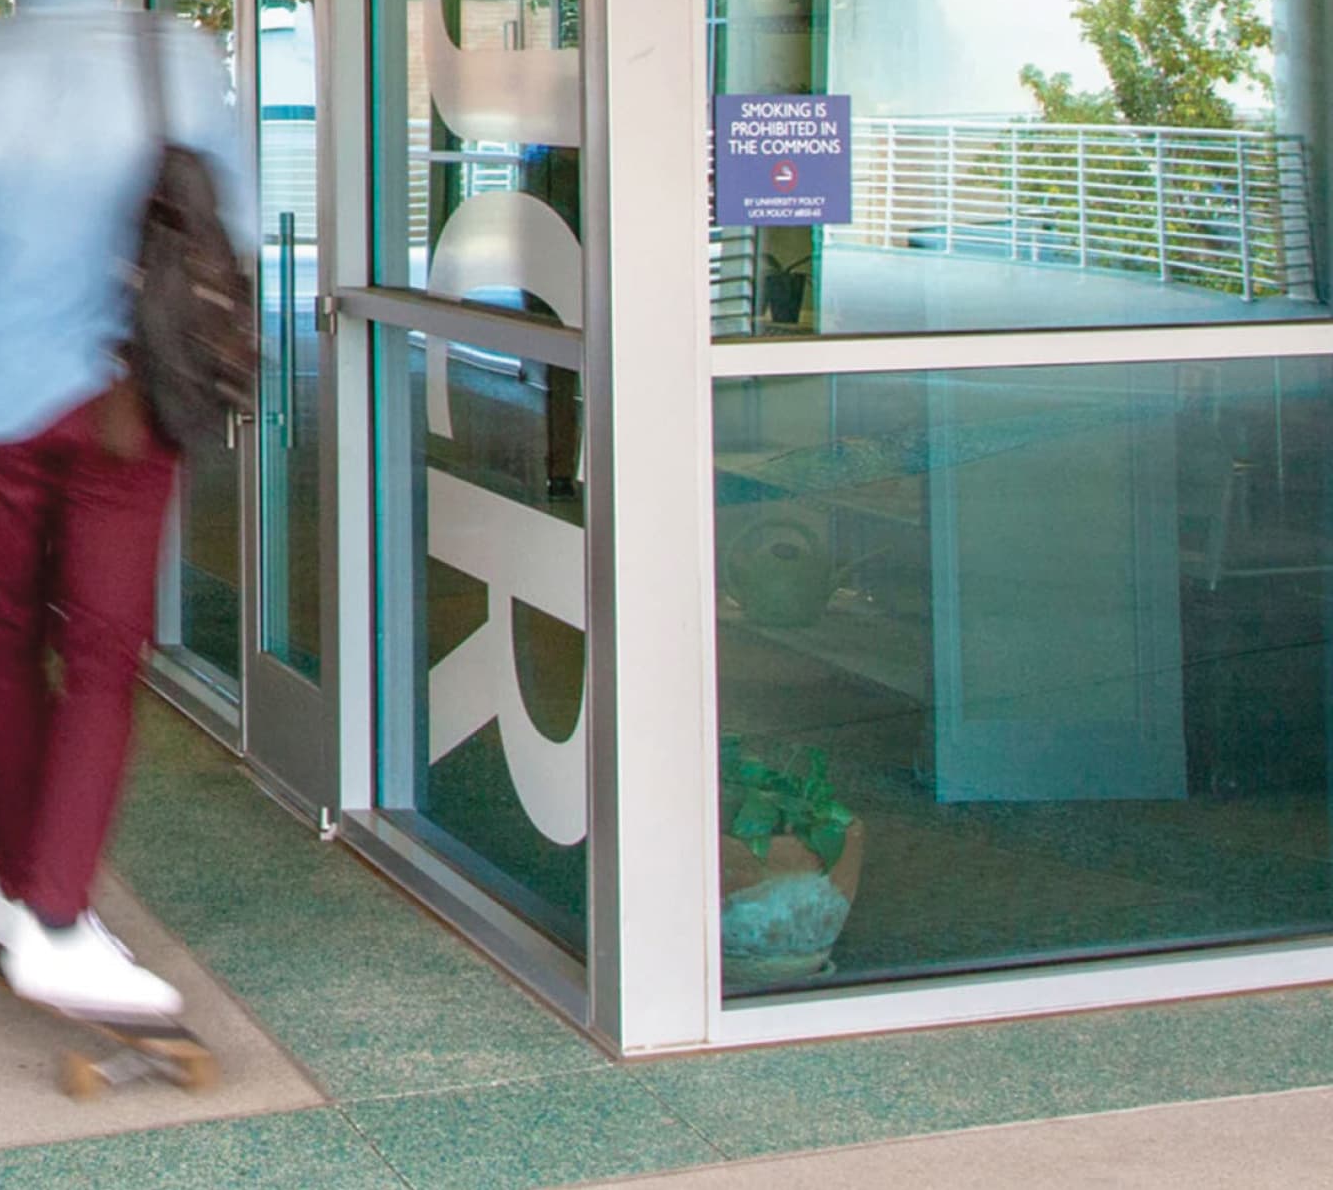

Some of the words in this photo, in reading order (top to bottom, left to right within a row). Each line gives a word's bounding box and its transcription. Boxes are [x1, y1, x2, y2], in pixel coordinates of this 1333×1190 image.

[741, 102, 812, 118] SMOKING
[814, 102, 827, 118] IS
[730, 121, 817, 137] PROHIBITED
[820, 121, 837, 136] IN
[727, 139, 758, 155] THE
[760, 139, 841, 155] COMMONS
[798, 196, 825, 206] POLICY
[766, 208, 793, 218] POLICY
